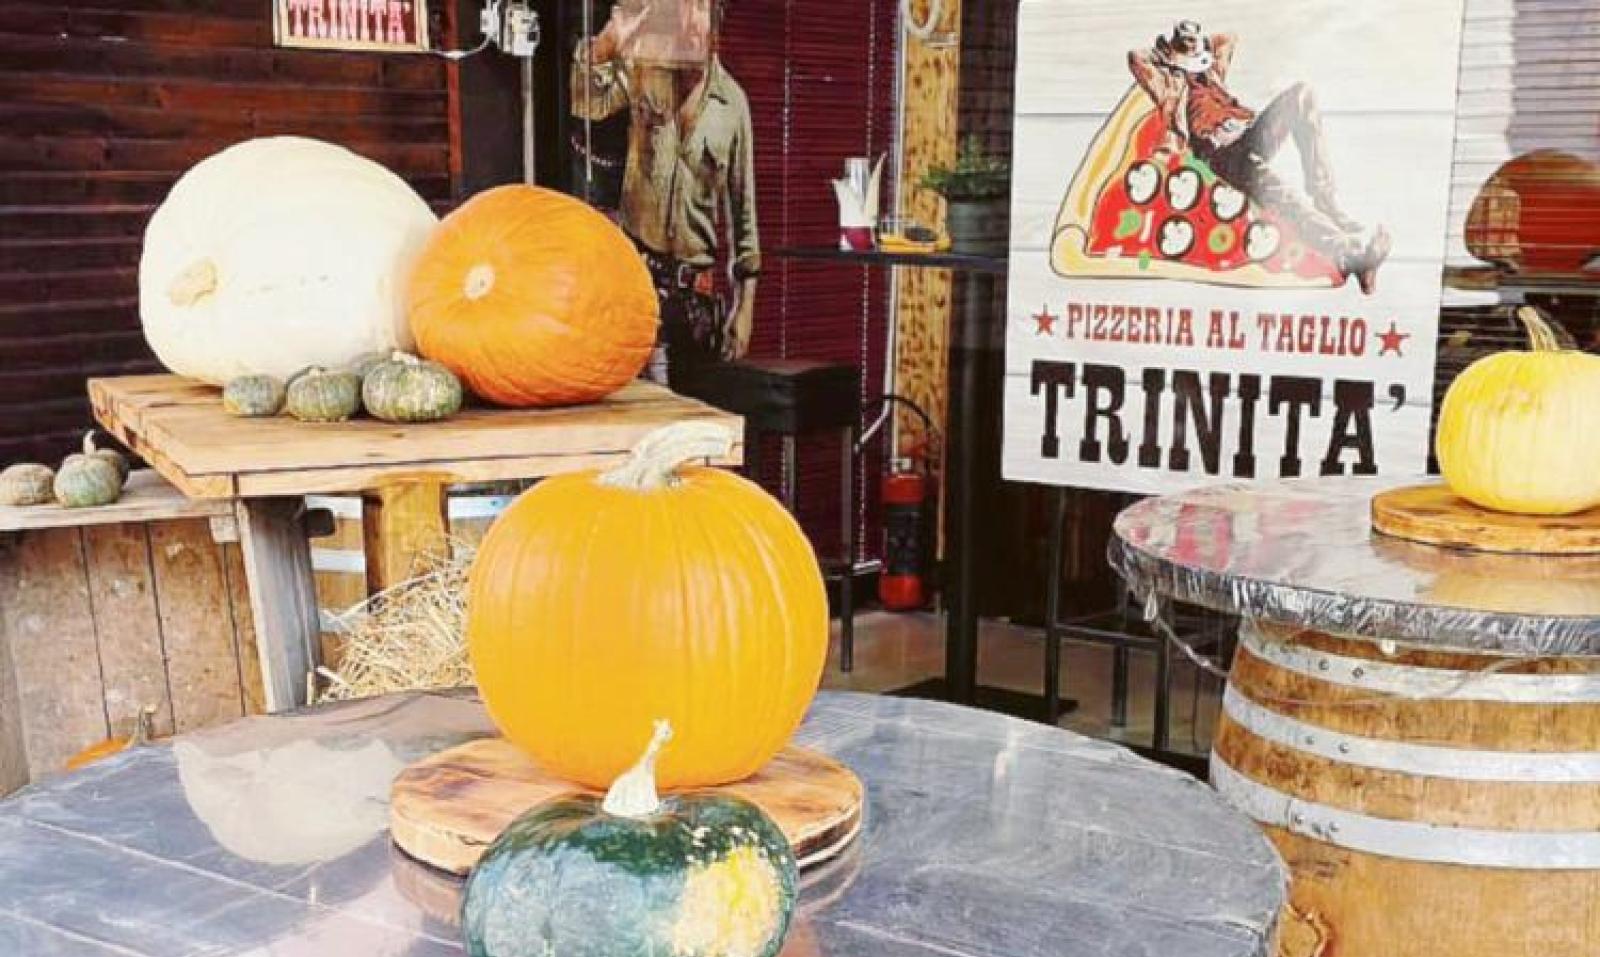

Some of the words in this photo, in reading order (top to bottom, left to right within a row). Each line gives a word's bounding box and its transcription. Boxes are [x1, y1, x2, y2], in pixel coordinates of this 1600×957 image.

[1066, 303, 1195, 347] PIZZERIA
[1206, 311, 1246, 350] AL
[1257, 313, 1368, 357] TAGLIO
